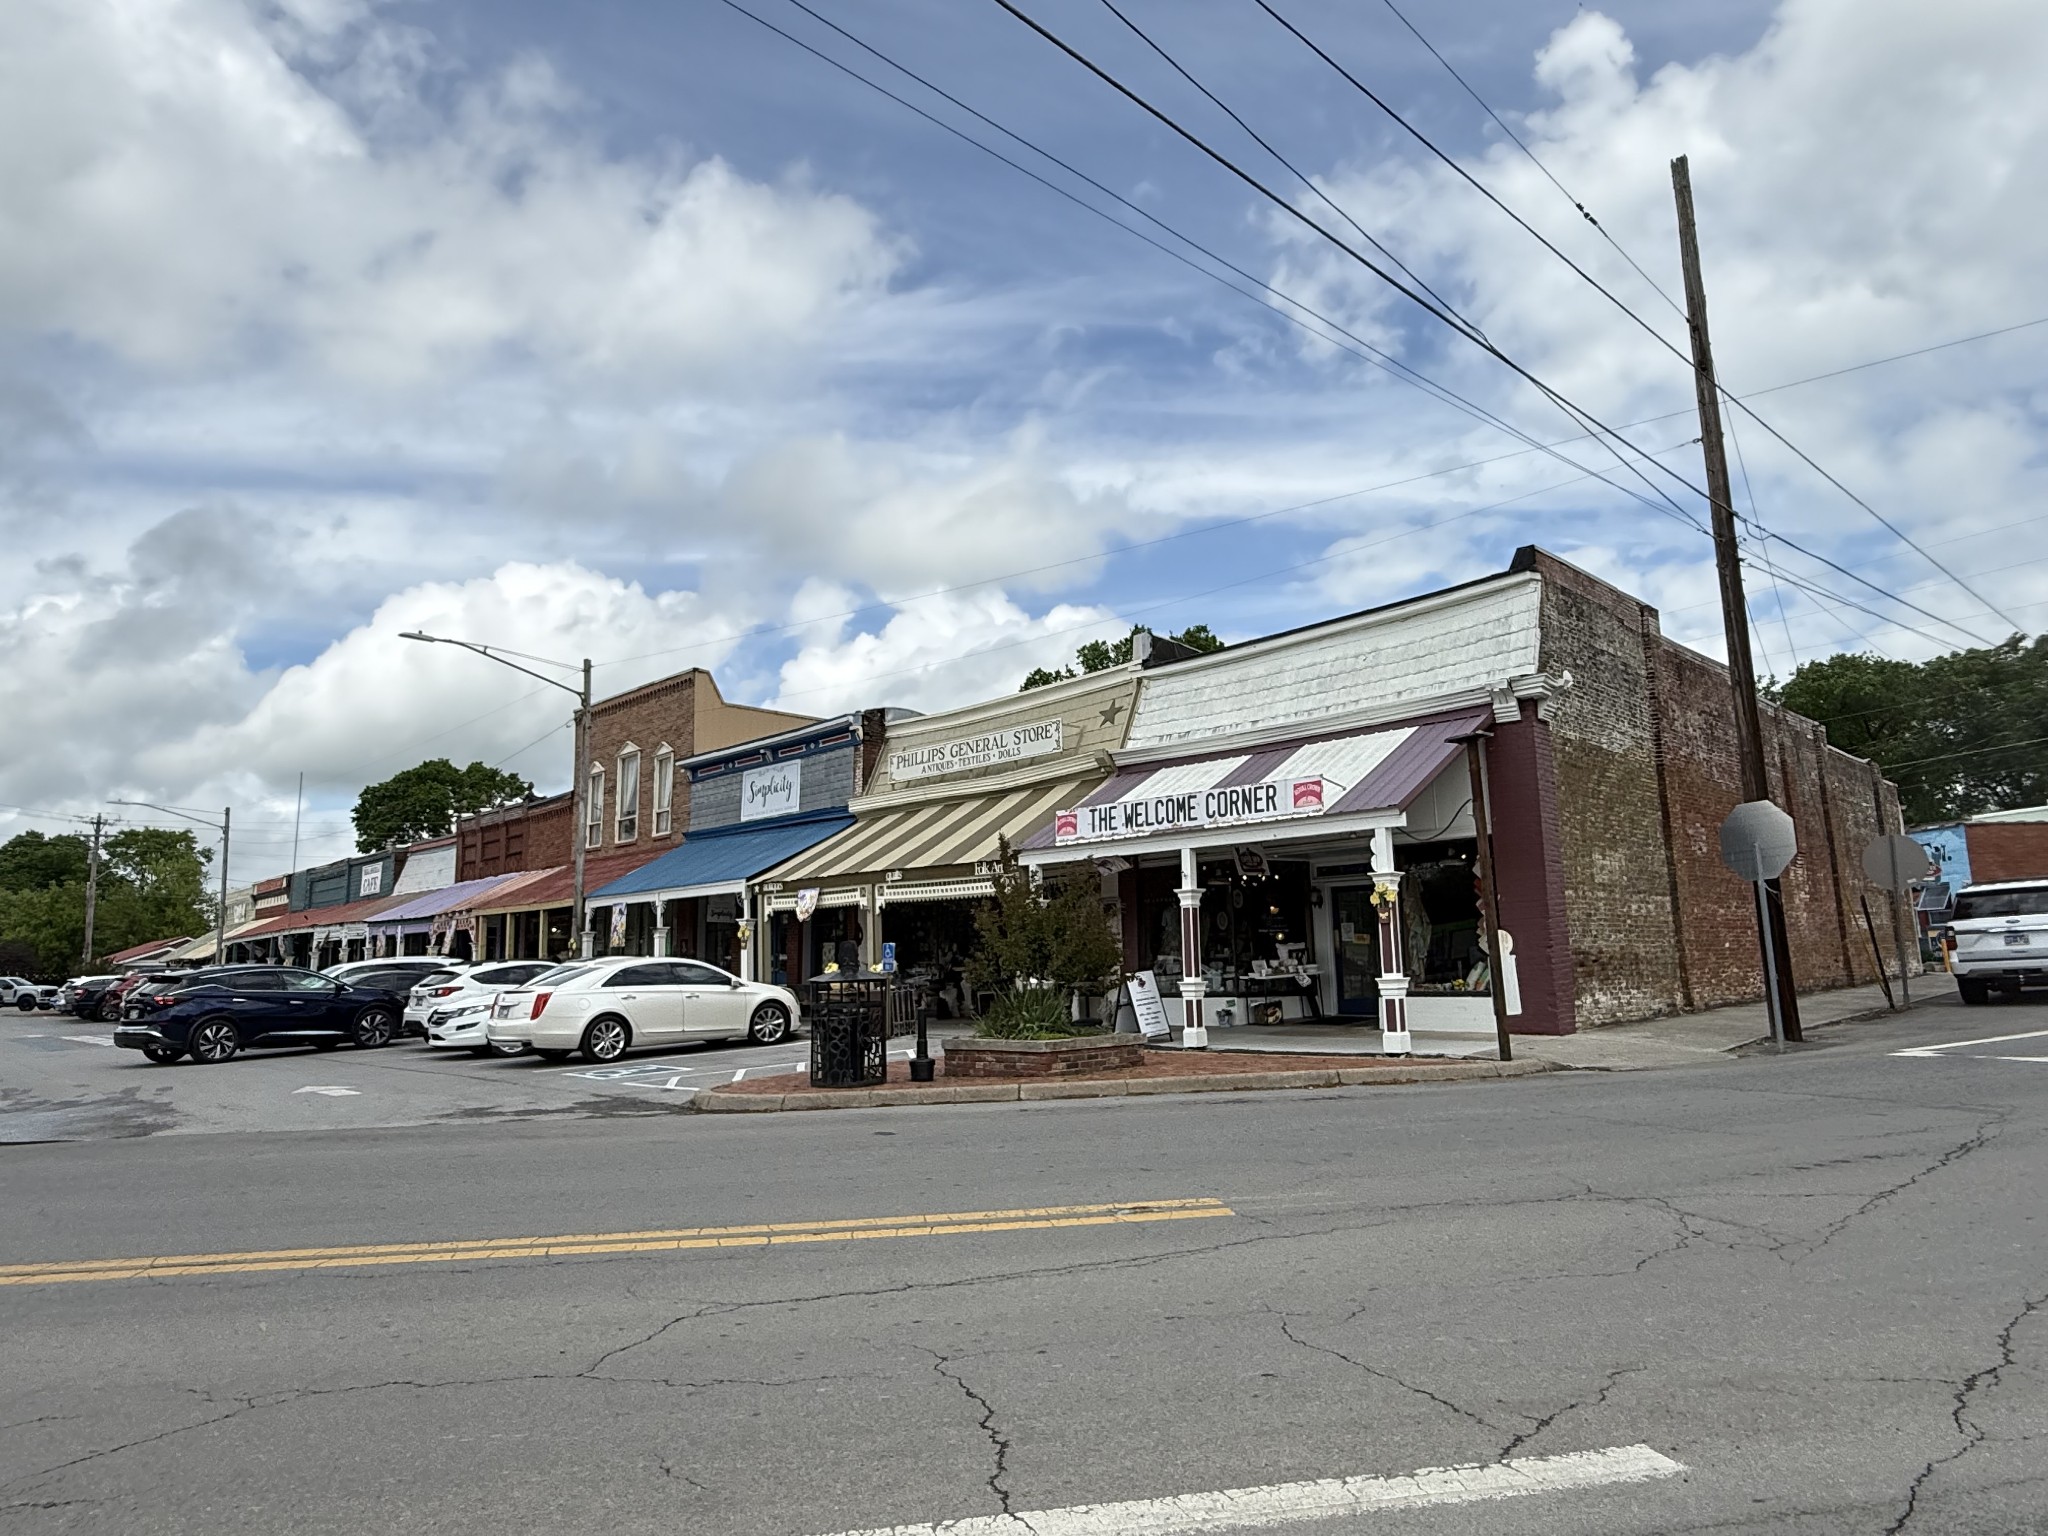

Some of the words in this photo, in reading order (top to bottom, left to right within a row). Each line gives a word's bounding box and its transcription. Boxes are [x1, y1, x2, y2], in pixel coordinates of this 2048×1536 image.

[896, 743, 946, 769] PHILLIPS'
[950, 733, 1009, 759] GENERAL
[1013, 723, 1053, 746] STORE
[998, 746, 1021, 759] DOLLS
[747, 774, 792, 807] Simplicity
[1089, 805, 1118, 833] THE
[1124, 794, 1198, 829] WELCOME
[1205, 784, 1277, 819] CORNER
